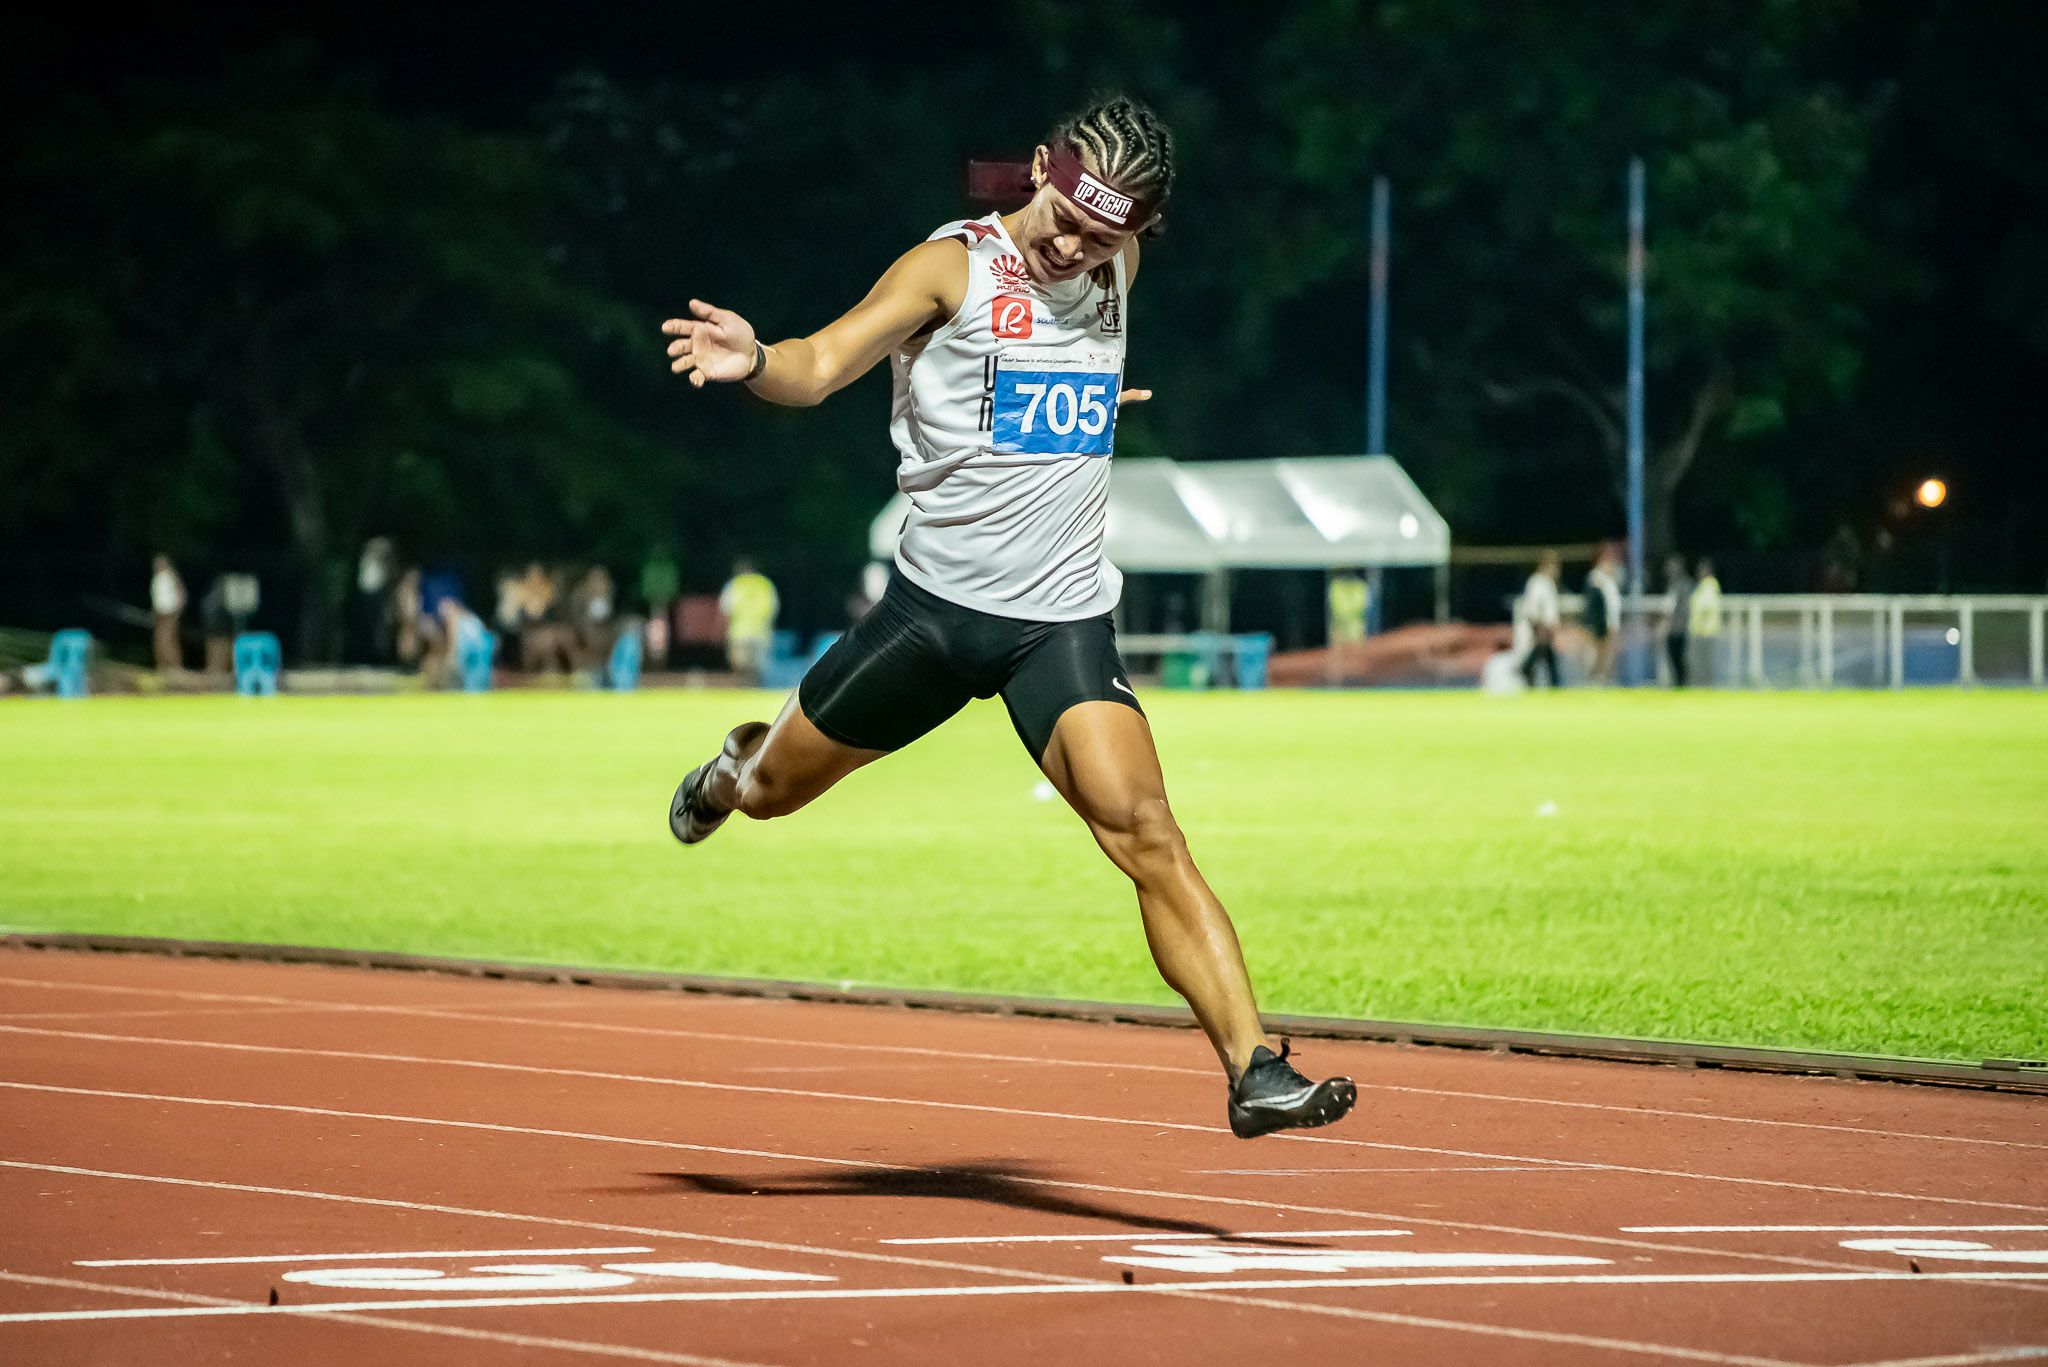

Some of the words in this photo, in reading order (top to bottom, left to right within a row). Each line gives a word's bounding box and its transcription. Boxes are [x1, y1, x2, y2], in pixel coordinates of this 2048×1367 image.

[1073, 182, 1096, 201] UP
[1092, 190, 1133, 217] FIGHT!
[1015, 383, 1108, 436] 705
